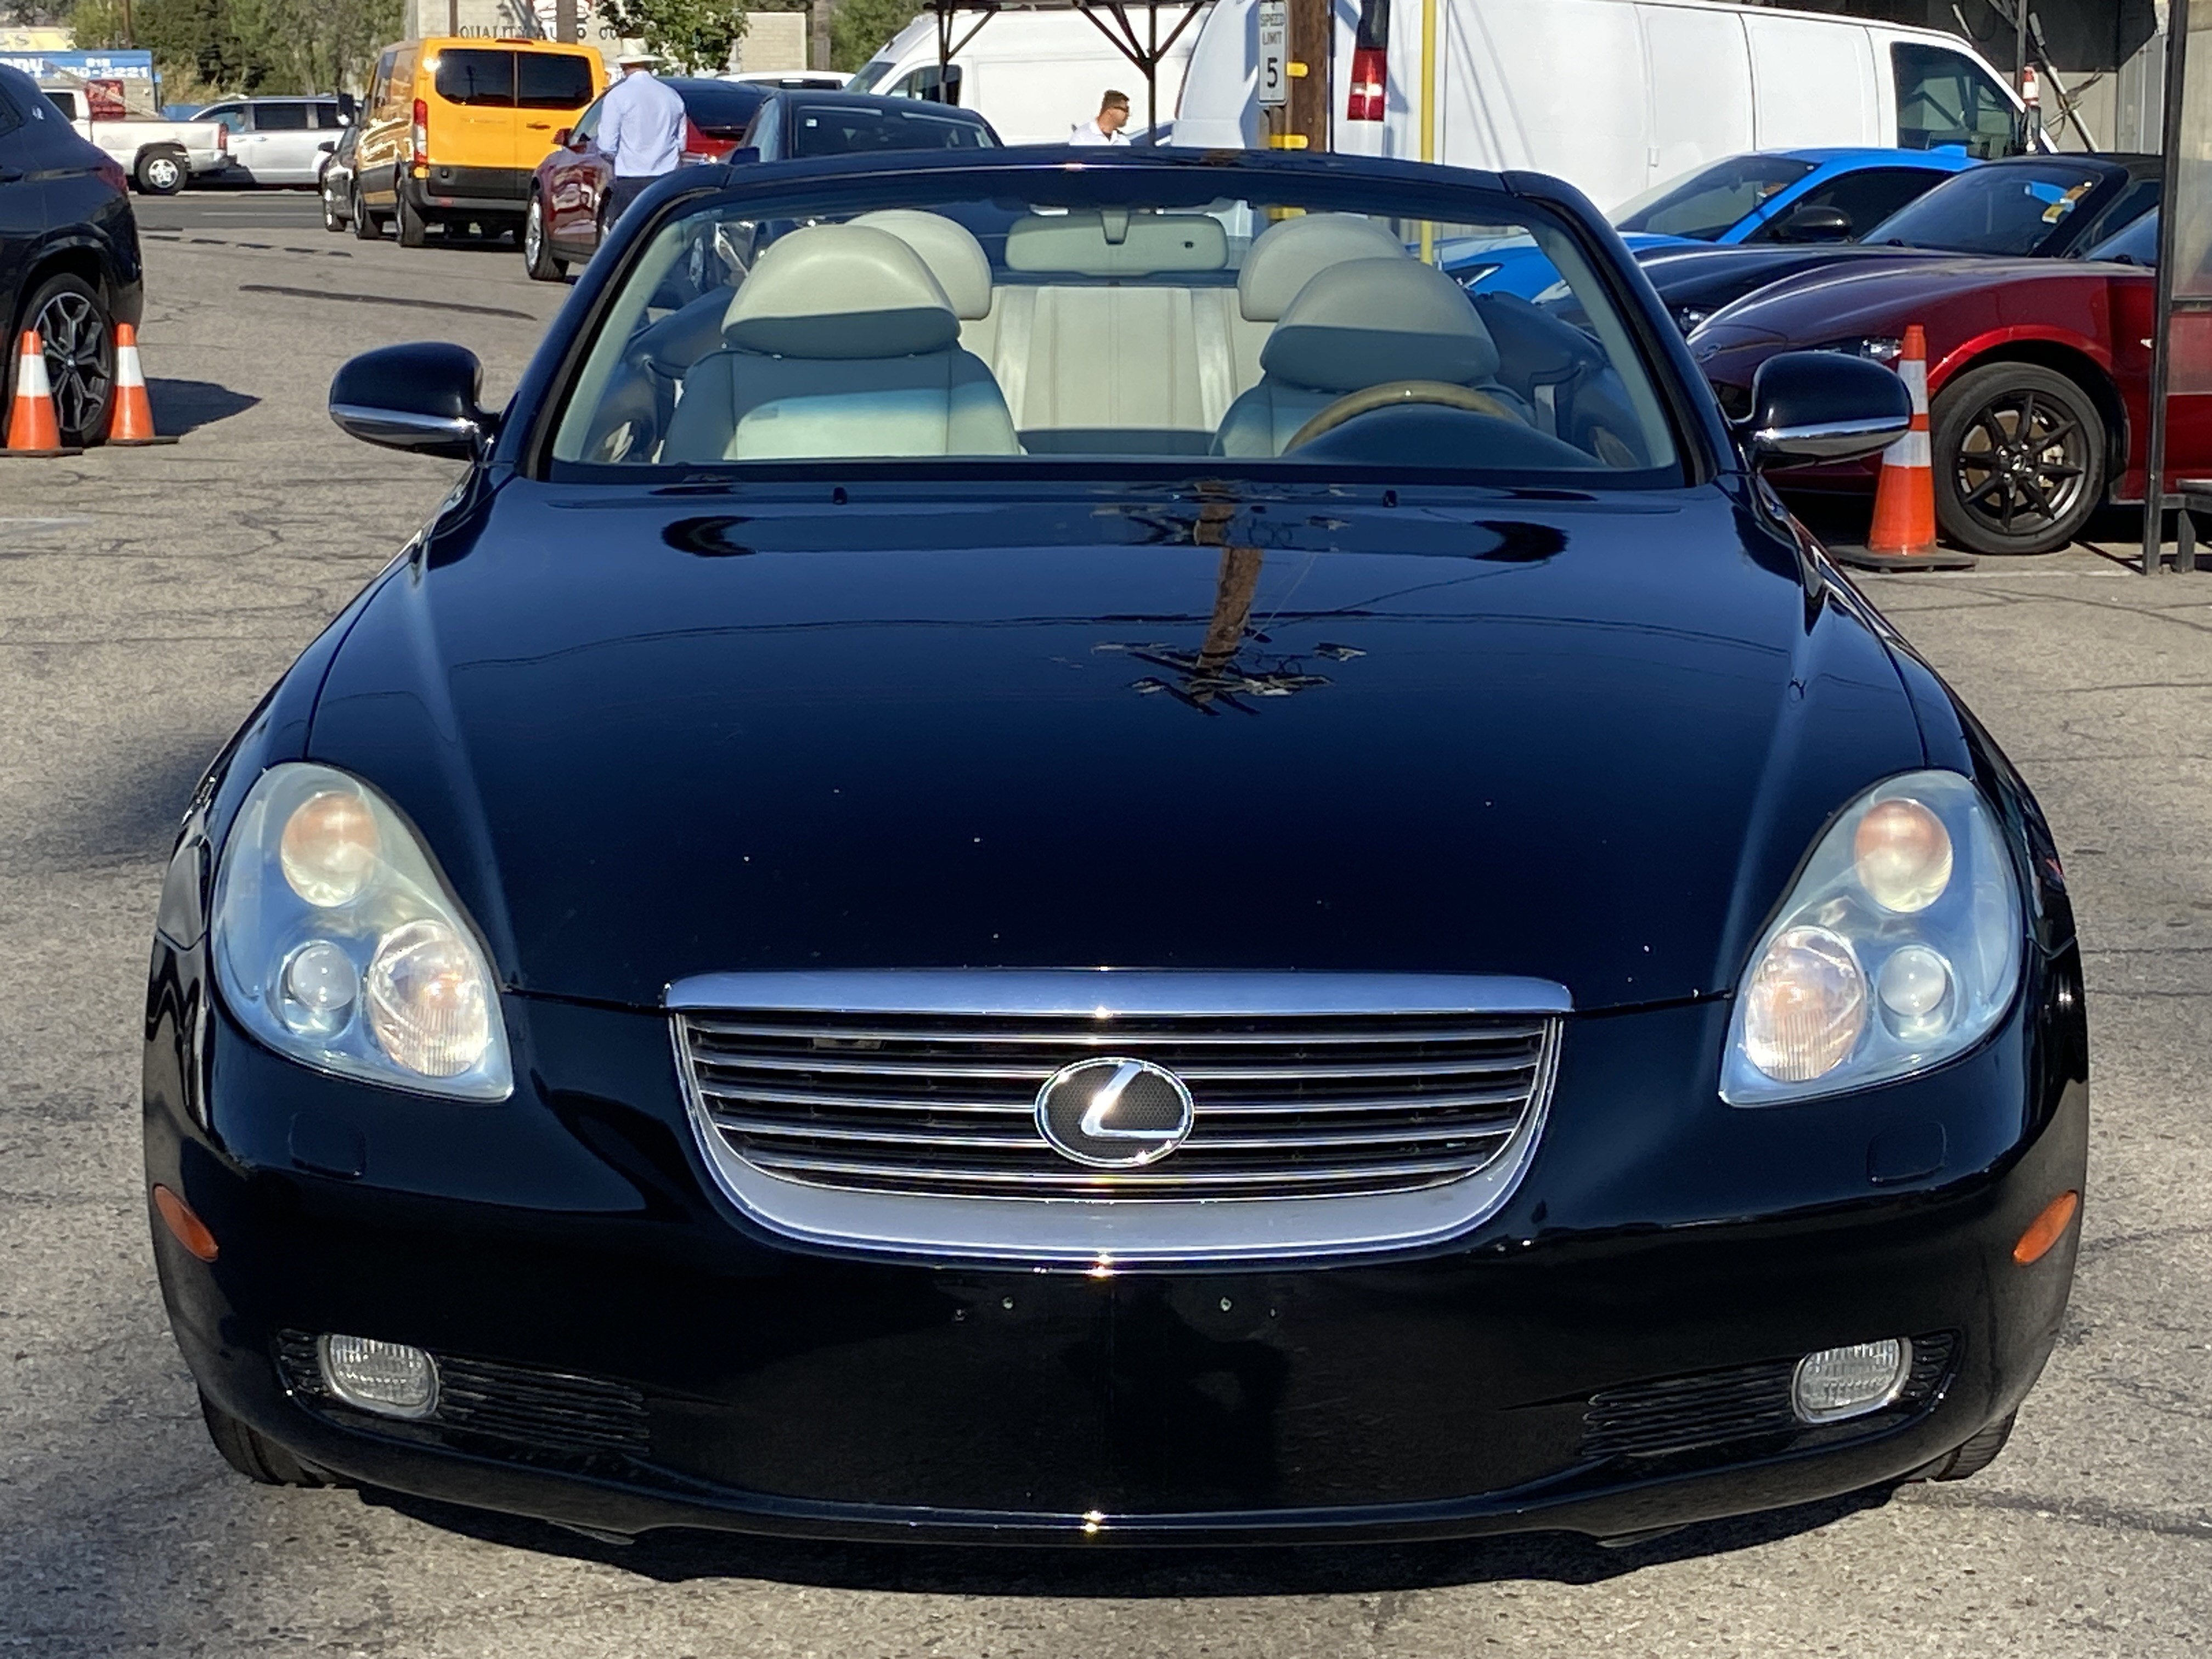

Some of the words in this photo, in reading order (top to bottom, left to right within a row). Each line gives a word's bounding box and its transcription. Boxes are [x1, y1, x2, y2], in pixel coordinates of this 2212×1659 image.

[460, 25, 527, 38] QUALITY
[537, 26, 586, 40] AUO
[1262, 31, 1282, 46] LIMIT
[1267, 57, 1278, 88] 5
